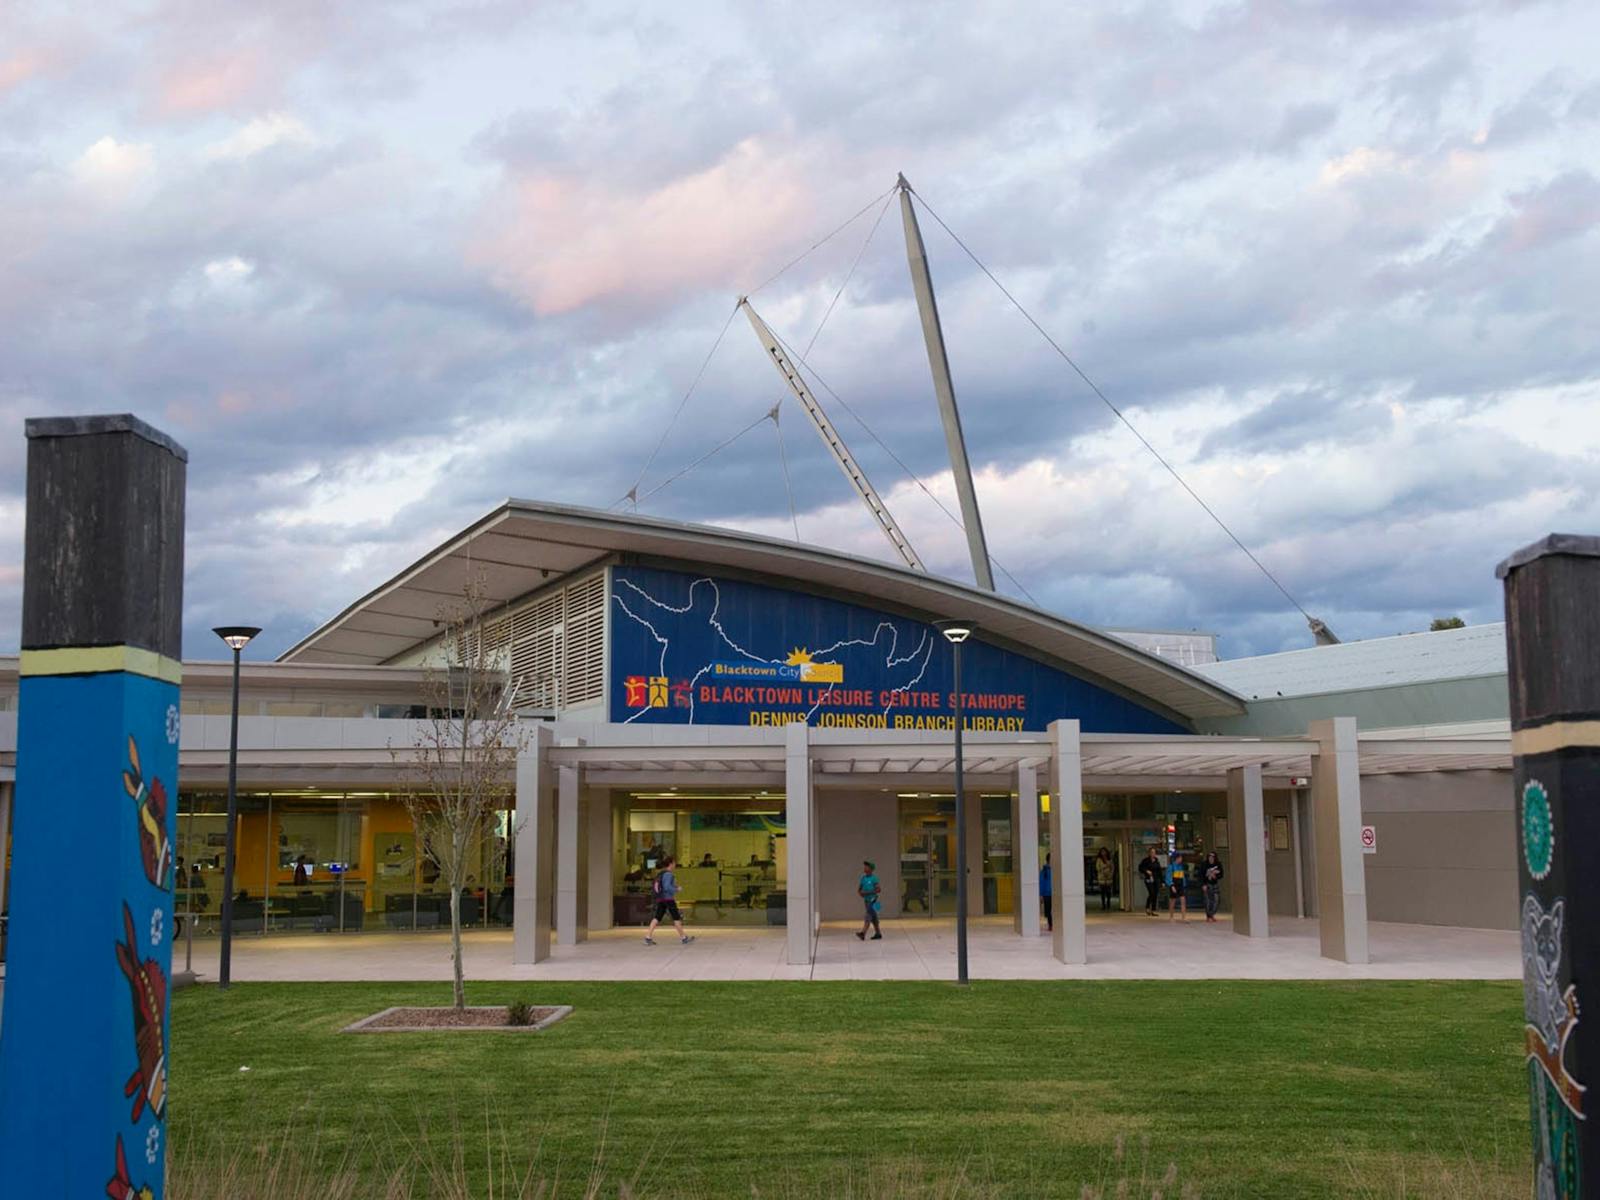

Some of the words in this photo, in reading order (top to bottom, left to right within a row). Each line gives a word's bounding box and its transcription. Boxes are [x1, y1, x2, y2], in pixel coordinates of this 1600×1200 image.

[715, 664, 776, 676] Blacktown
[778, 665, 800, 678] City
[700, 685, 803, 703] BLACKTOWN
[808, 688, 873, 706] LEISURE
[879, 690, 940, 708] CENTRE
[948, 693, 1025, 710] STANHOPE
[750, 711, 806, 728] DENNIS
[816, 713, 887, 729] JOHNSON
[894, 715, 956, 731] BRANCH
[963, 716, 1025, 732] LIBRARY
